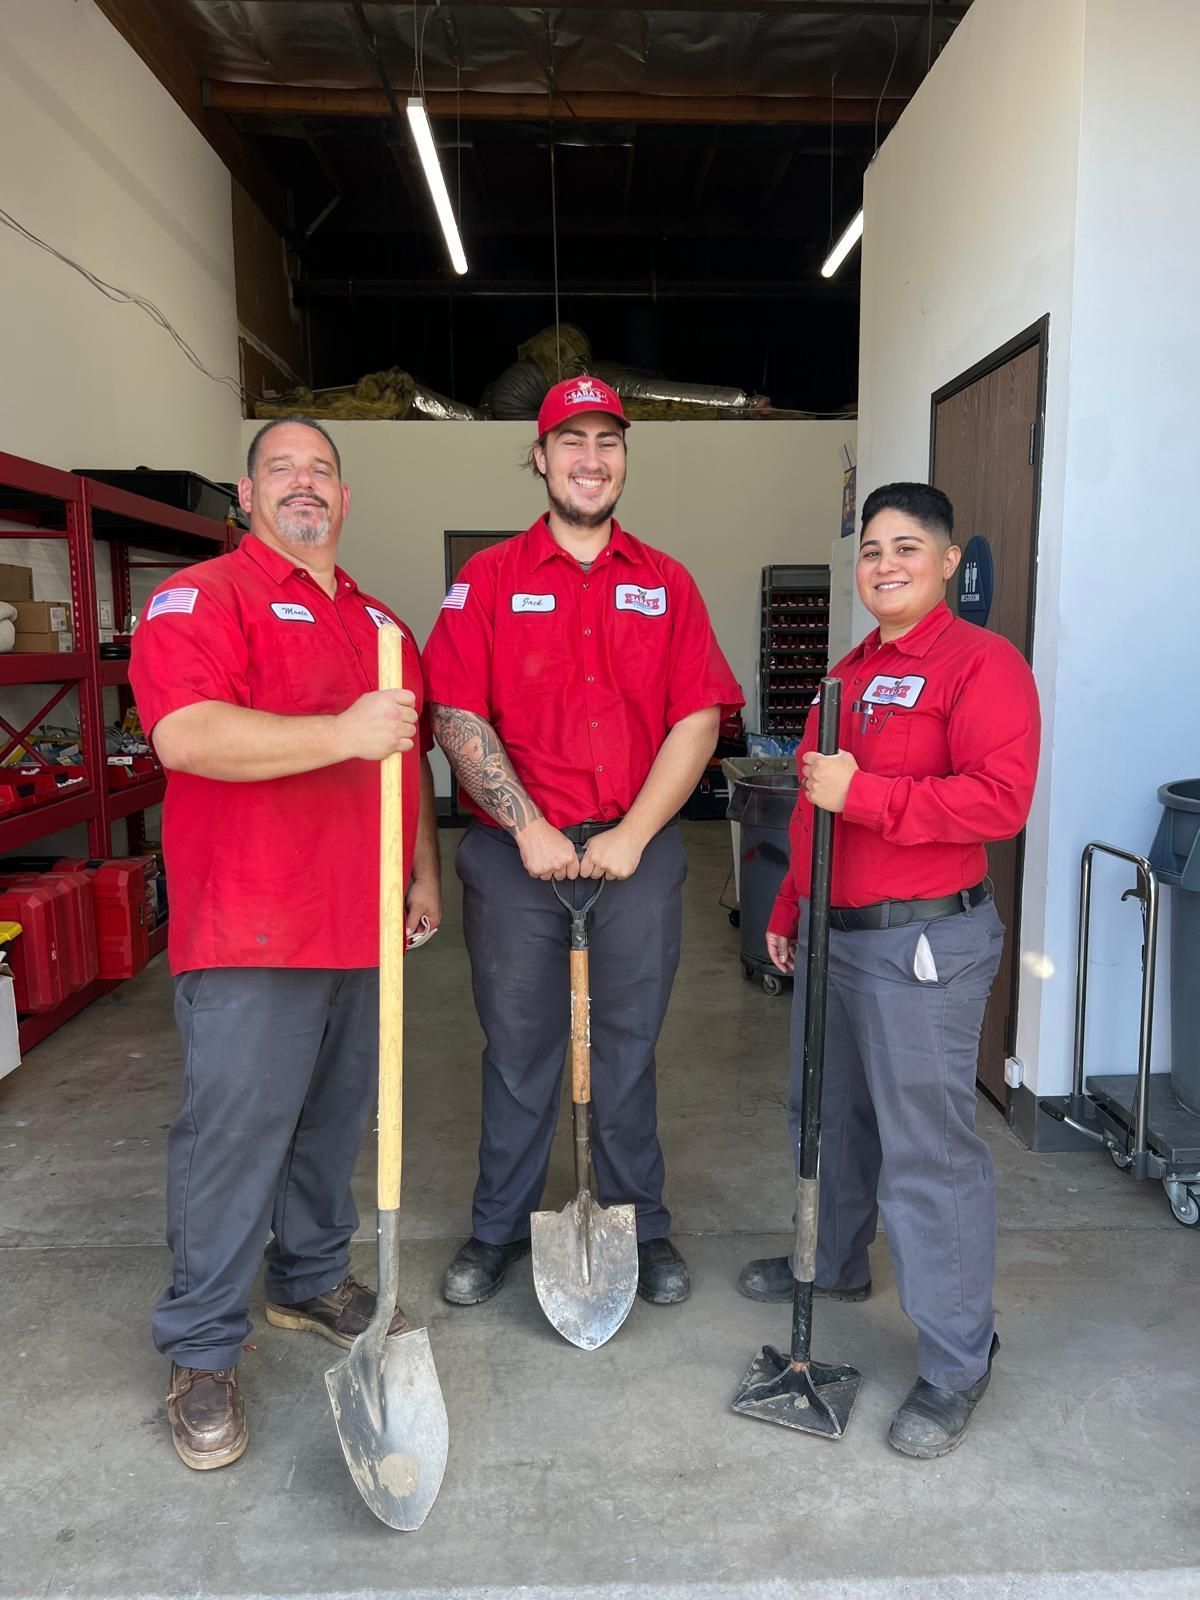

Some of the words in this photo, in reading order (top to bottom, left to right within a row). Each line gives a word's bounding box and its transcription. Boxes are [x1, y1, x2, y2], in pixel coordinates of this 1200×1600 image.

[571, 390, 601, 399] SARA'S
[521, 597, 542, 607] Jack
[960, 594, 980, 602] RESTROOM
